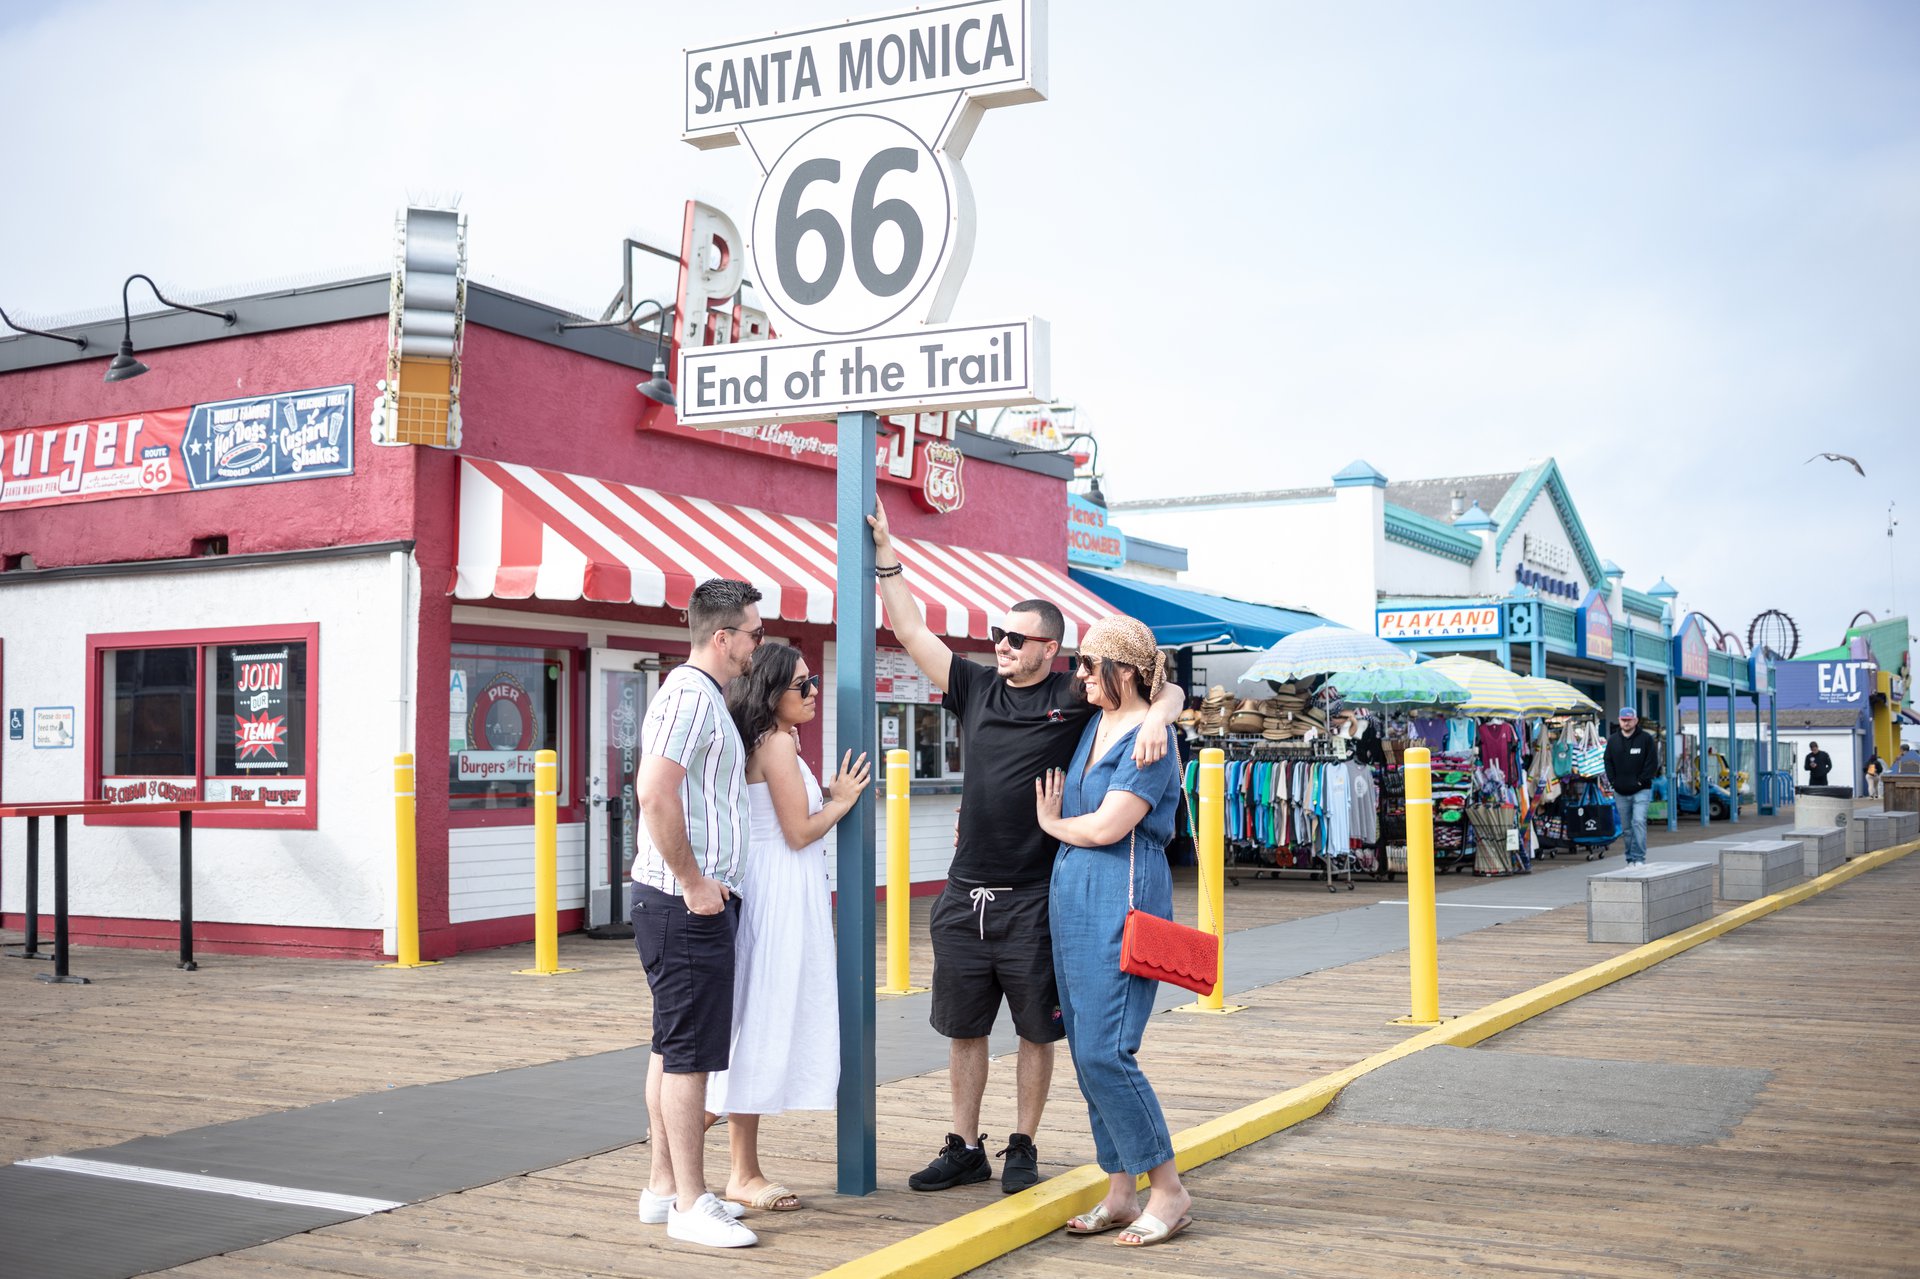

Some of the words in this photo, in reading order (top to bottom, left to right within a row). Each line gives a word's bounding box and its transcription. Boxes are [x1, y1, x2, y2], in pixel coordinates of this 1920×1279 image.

[694, 45, 822, 115] SANTA
[838, 12, 1015, 94] MONICA
[774, 146, 924, 306] 66
[696, 355, 768, 408] End
[783, 349, 826, 401] of
[839, 346, 905, 396] the
[919, 331, 1012, 389] Trail
[214, 426, 235, 467] Hot
[233, 420, 267, 444] Dogs
[279, 415, 329, 457] Custard
[0, 418, 145, 494] urger
[144, 447, 167, 458] ROUTE
[291, 442, 340, 473] Shakes
[143, 462, 167, 484] 66
[929, 467, 955, 500] 66
[4, 484, 21, 497] SANTA
[22, 483, 43, 496] MONICA
[44, 482, 57, 492] PIER
[1382, 610, 1495, 629] PLAYLAND
[1399, 627, 1478, 636] ARCADE
[237, 662, 283, 692] JOIN
[450, 672, 463, 692] A
[1818, 663, 1860, 693] EAT
[252, 695, 267, 709] OUR
[488, 685, 519, 701] PIER
[243, 721, 276, 741] TEAM
[623, 687, 634, 773] CUSTARD
[461, 755, 505, 778] Burgers
[104, 784, 117, 803] ICE
[117, 782, 147, 803] CREAM
[231, 785, 254, 801] Pier
[258, 786, 301, 805] Burger
[623, 786, 634, 861] SHAKES
